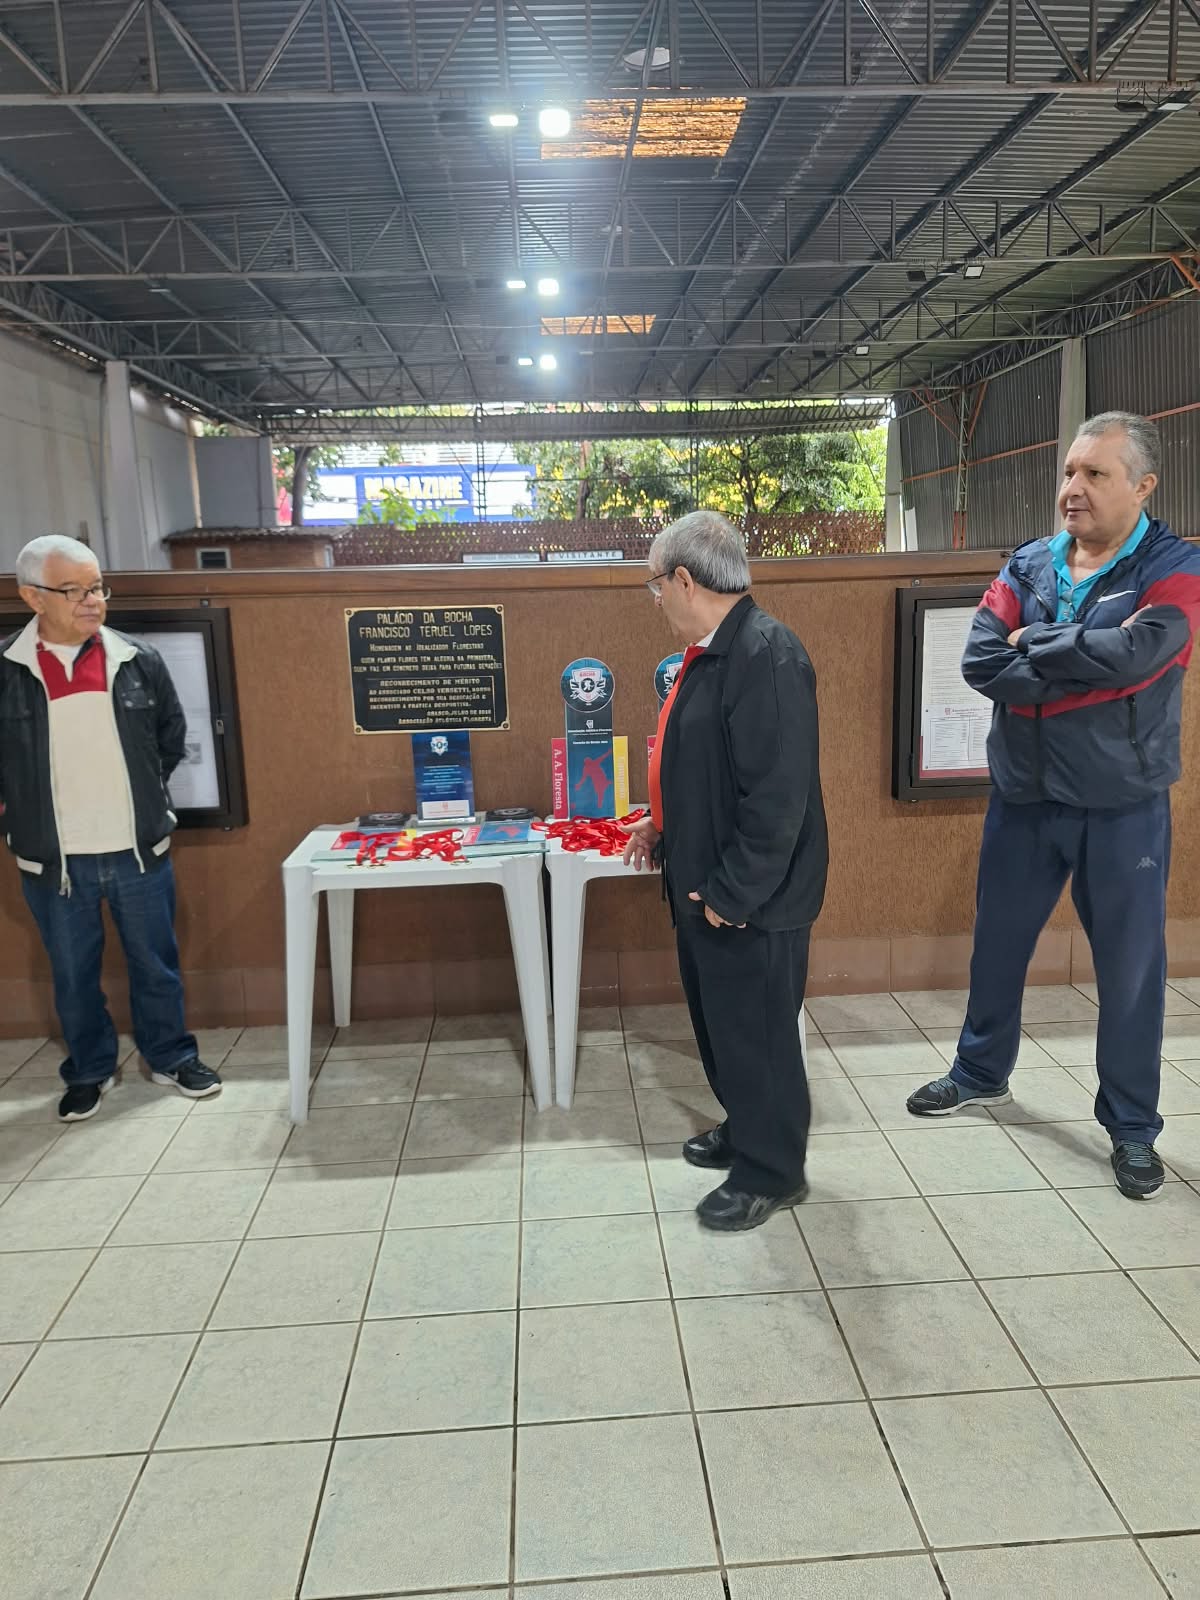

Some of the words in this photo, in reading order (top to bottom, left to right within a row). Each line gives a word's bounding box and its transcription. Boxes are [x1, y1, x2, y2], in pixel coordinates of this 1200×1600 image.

[364, 476, 463, 500] MAGAZINE
[560, 551, 617, 559] VISITANTE
[377, 611, 414, 624] PALÁCIO
[423, 612, 435, 624] DA
[444, 611, 473, 623] BOCHA
[359, 626, 410, 638] FRANCISCO
[419, 625, 455, 638] TERUEL
[464, 624, 493, 636] LOPES
[554, 772, 564, 810] Floresta
